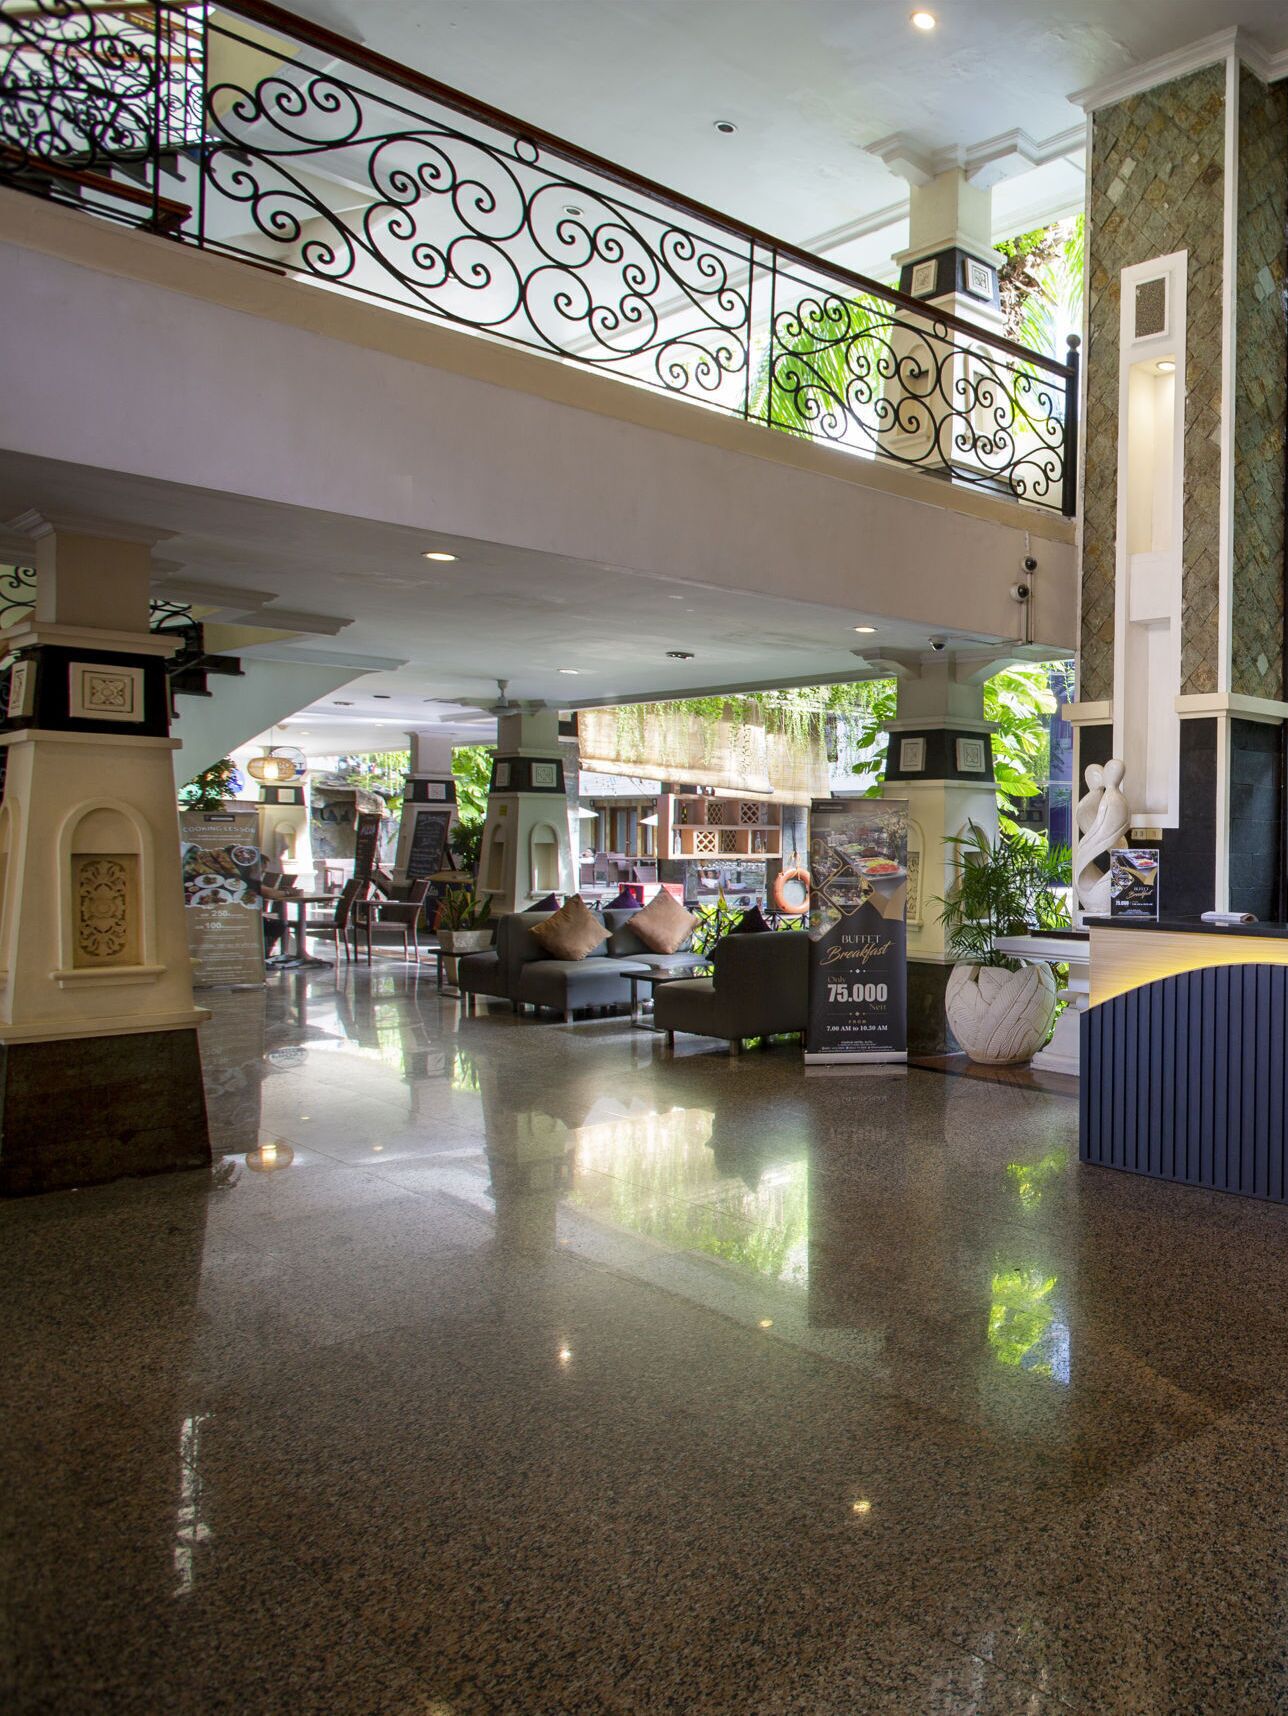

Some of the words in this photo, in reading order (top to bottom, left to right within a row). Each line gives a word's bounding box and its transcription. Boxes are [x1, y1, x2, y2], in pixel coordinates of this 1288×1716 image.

[841, 934, 880, 944] BUFFET
[819, 940, 896, 966] Breakfast
[827, 983, 888, 1002] 75.000
